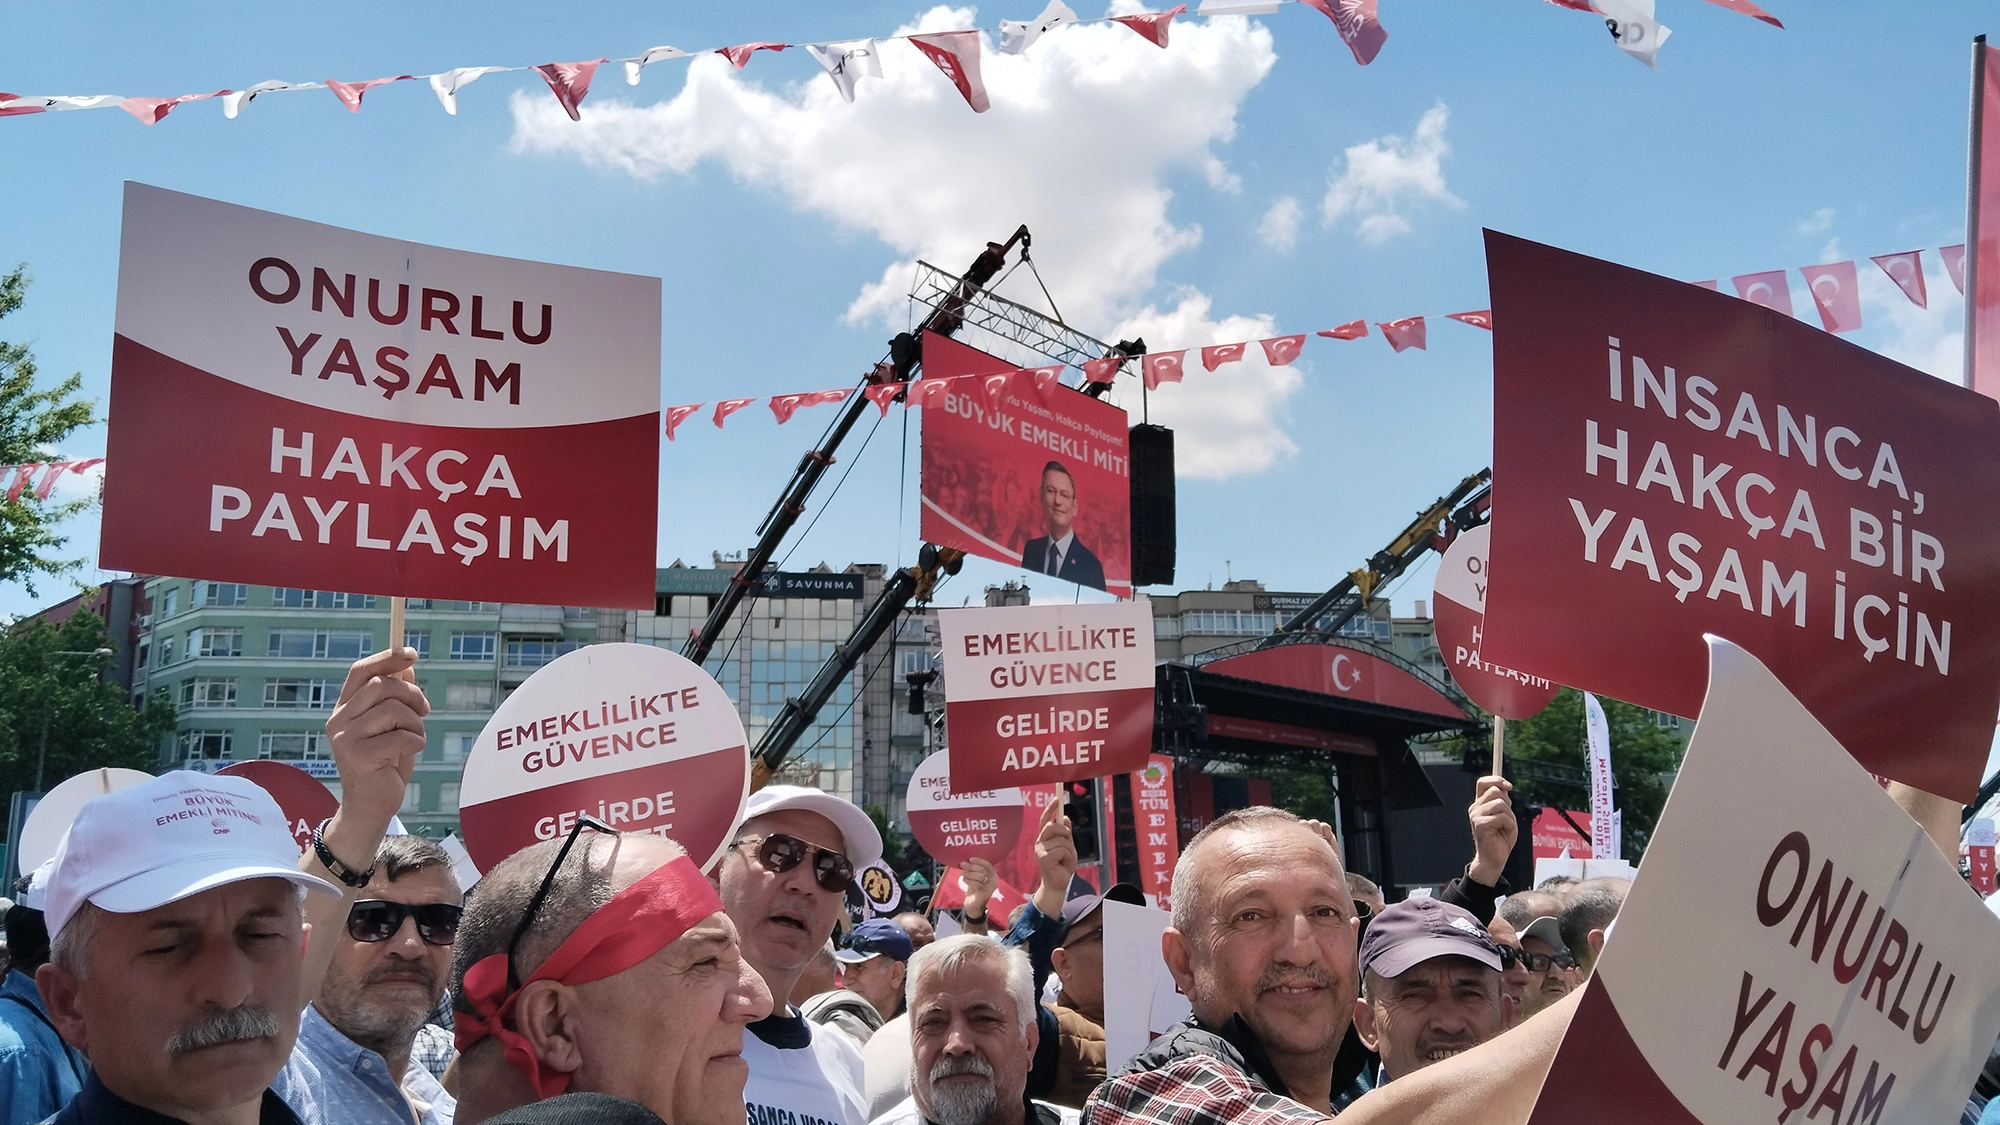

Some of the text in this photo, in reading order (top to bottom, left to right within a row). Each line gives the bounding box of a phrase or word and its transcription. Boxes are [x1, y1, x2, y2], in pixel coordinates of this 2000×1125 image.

[248, 256, 553, 346] ONURLU
[275, 325, 522, 406] YAŞAM
[1020, 420, 1089, 463] EMEKLİ
[1607, 335, 1925, 515] İNSANCA,
[269, 426, 523, 503] HAKÇA
[208, 484, 570, 567] PAYLAŞIM
[1584, 418, 1946, 593] HAKÇA BİR
[786, 579, 855, 591] SAVUNMA
[1567, 497, 1952, 677] YAŞAM İÇİN
[964, 624, 1137, 657] EMEKLİLİKTE
[989, 660, 1117, 689] GÜVENCE
[496, 686, 701, 752] EMEKLİLİKTE
[996, 706, 1110, 738] GELİRDE
[521, 721, 678, 774] GÜVENCE
[1000, 739, 1106, 772] ADALET
[155, 805, 213, 827] EMEKLİ
[184, 794, 235, 807] BÜYÜK
[1139, 796, 1170, 811] TÜM
[940, 818, 999, 833] GELİRDE
[944, 833, 998, 848] ADALET
[1755, 830, 1956, 1046] ONURLU
[1716, 970, 1898, 1125] YAŞAM
